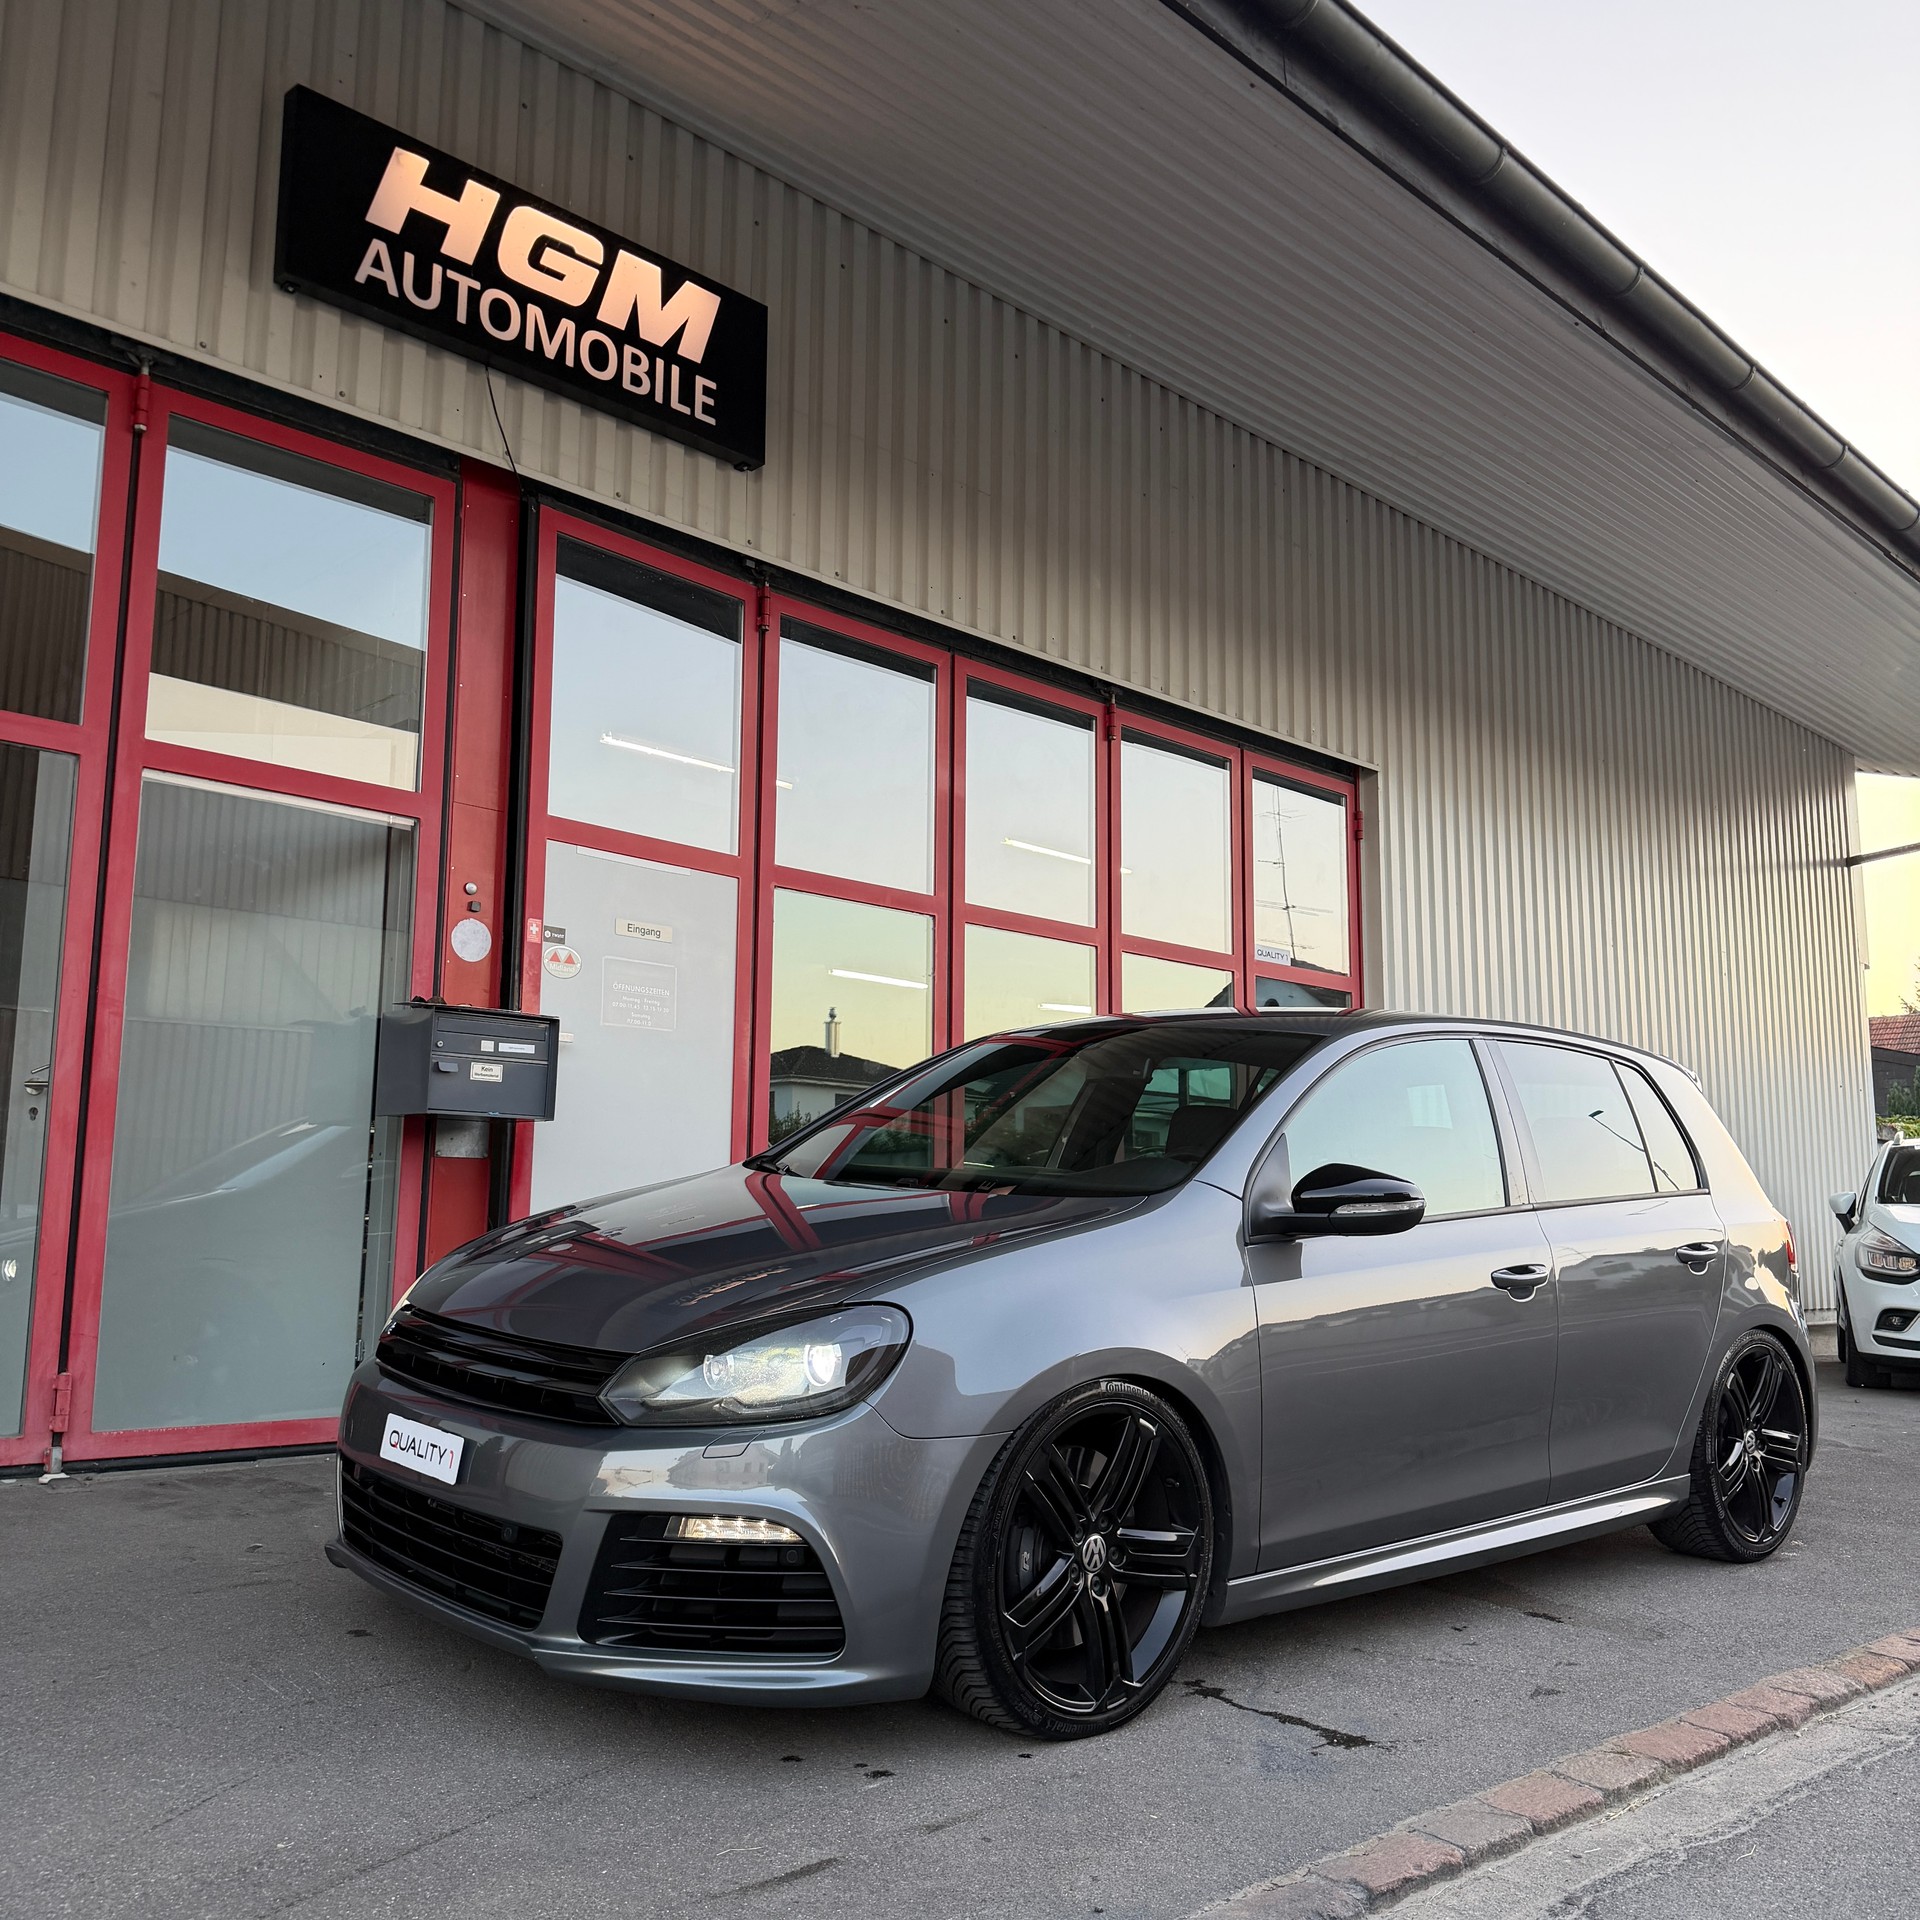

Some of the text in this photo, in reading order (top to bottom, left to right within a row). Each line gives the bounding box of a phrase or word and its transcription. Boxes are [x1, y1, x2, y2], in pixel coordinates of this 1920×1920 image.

[364, 146, 722, 364] HGM
[354, 238, 717, 426] AUTOMOBILE
[627, 922, 661, 939] Eingang
[612, 981, 670, 996] ÖFFNUNGSZEITEN
